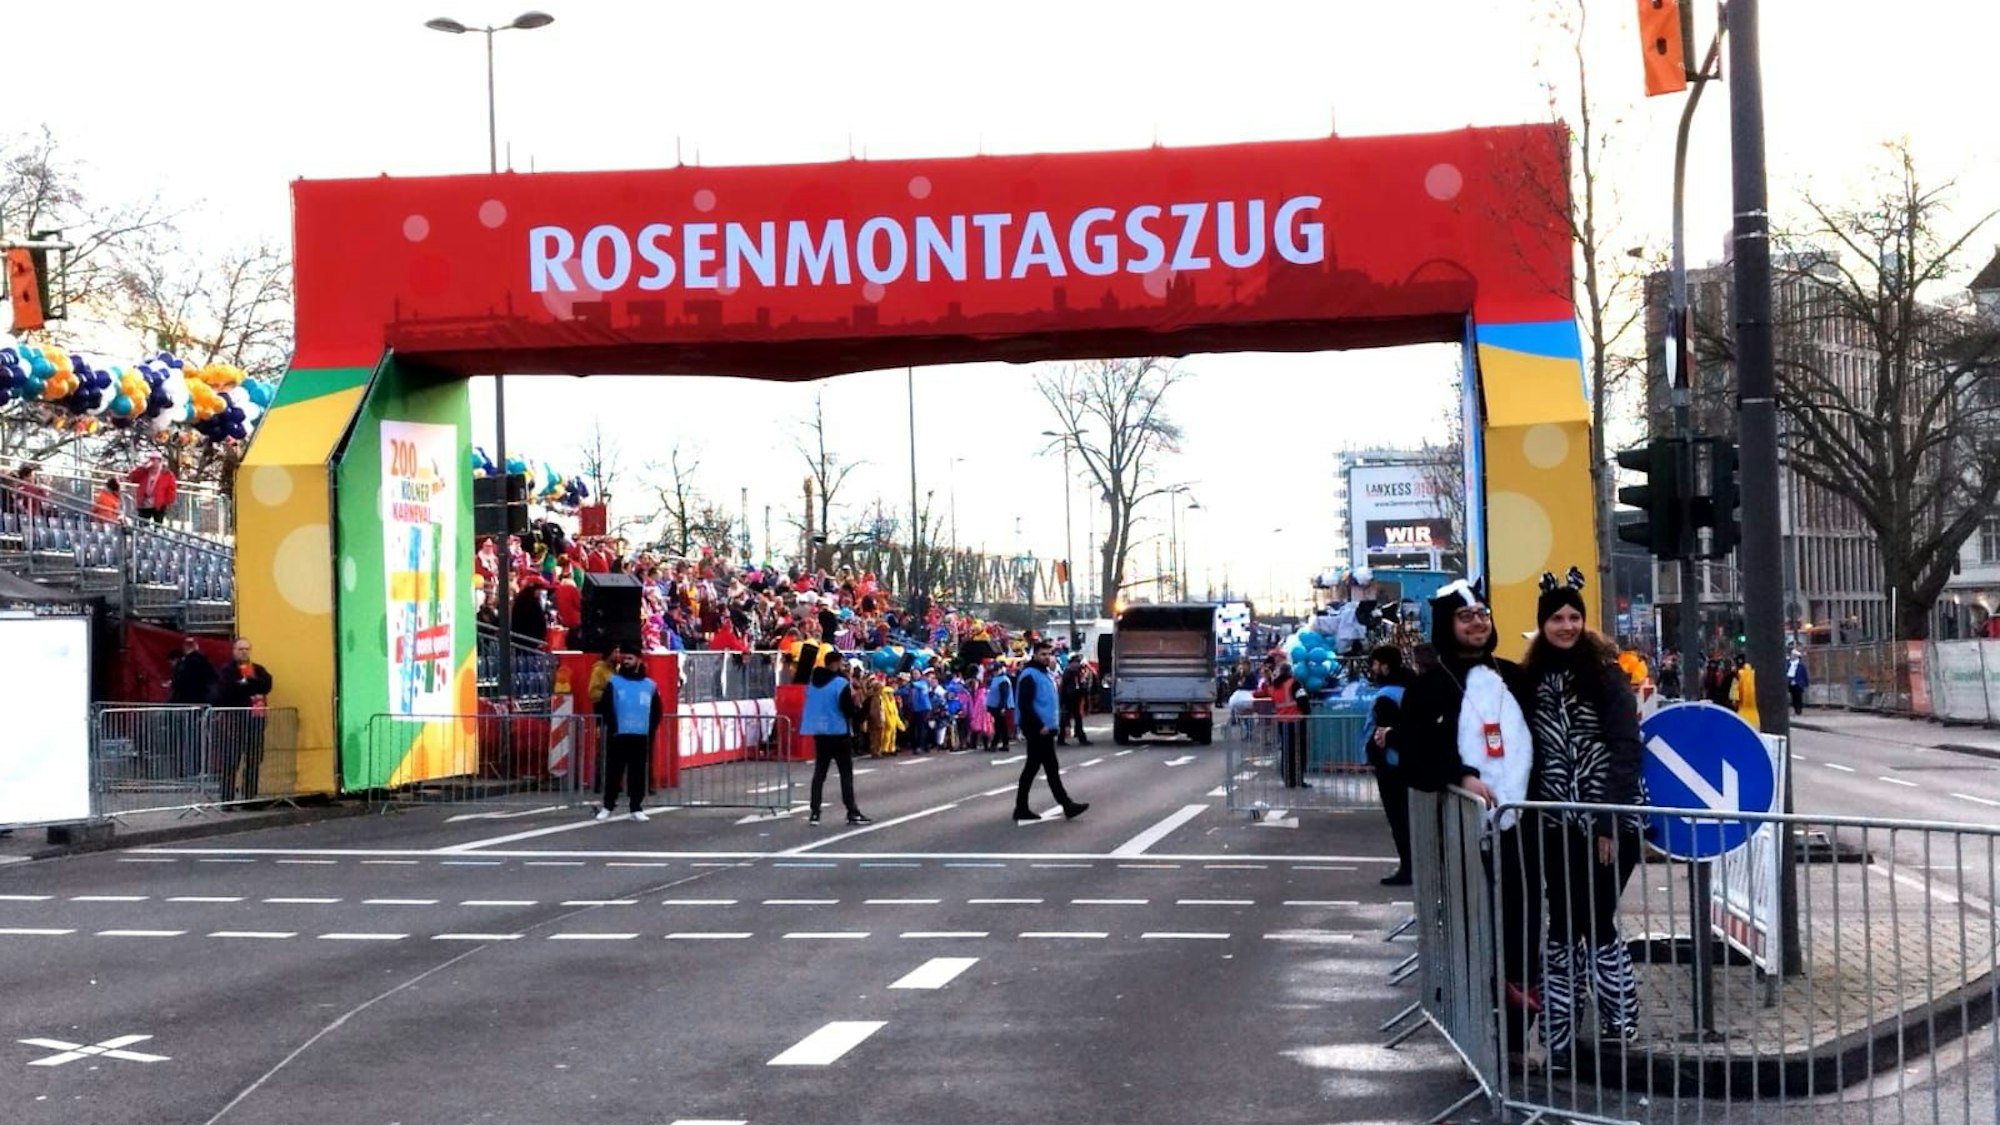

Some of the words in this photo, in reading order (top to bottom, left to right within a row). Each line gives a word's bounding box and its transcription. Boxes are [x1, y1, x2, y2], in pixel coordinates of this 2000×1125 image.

[529, 195, 1325, 293] ROSENMONTAGSZUG
[391, 438, 417, 478] 200
[401, 478, 430, 502] KÖLNER
[1366, 483, 1412, 497] LANXESS
[392, 502, 432, 525] KARNEVAL
[1385, 526, 1432, 543] WIR
